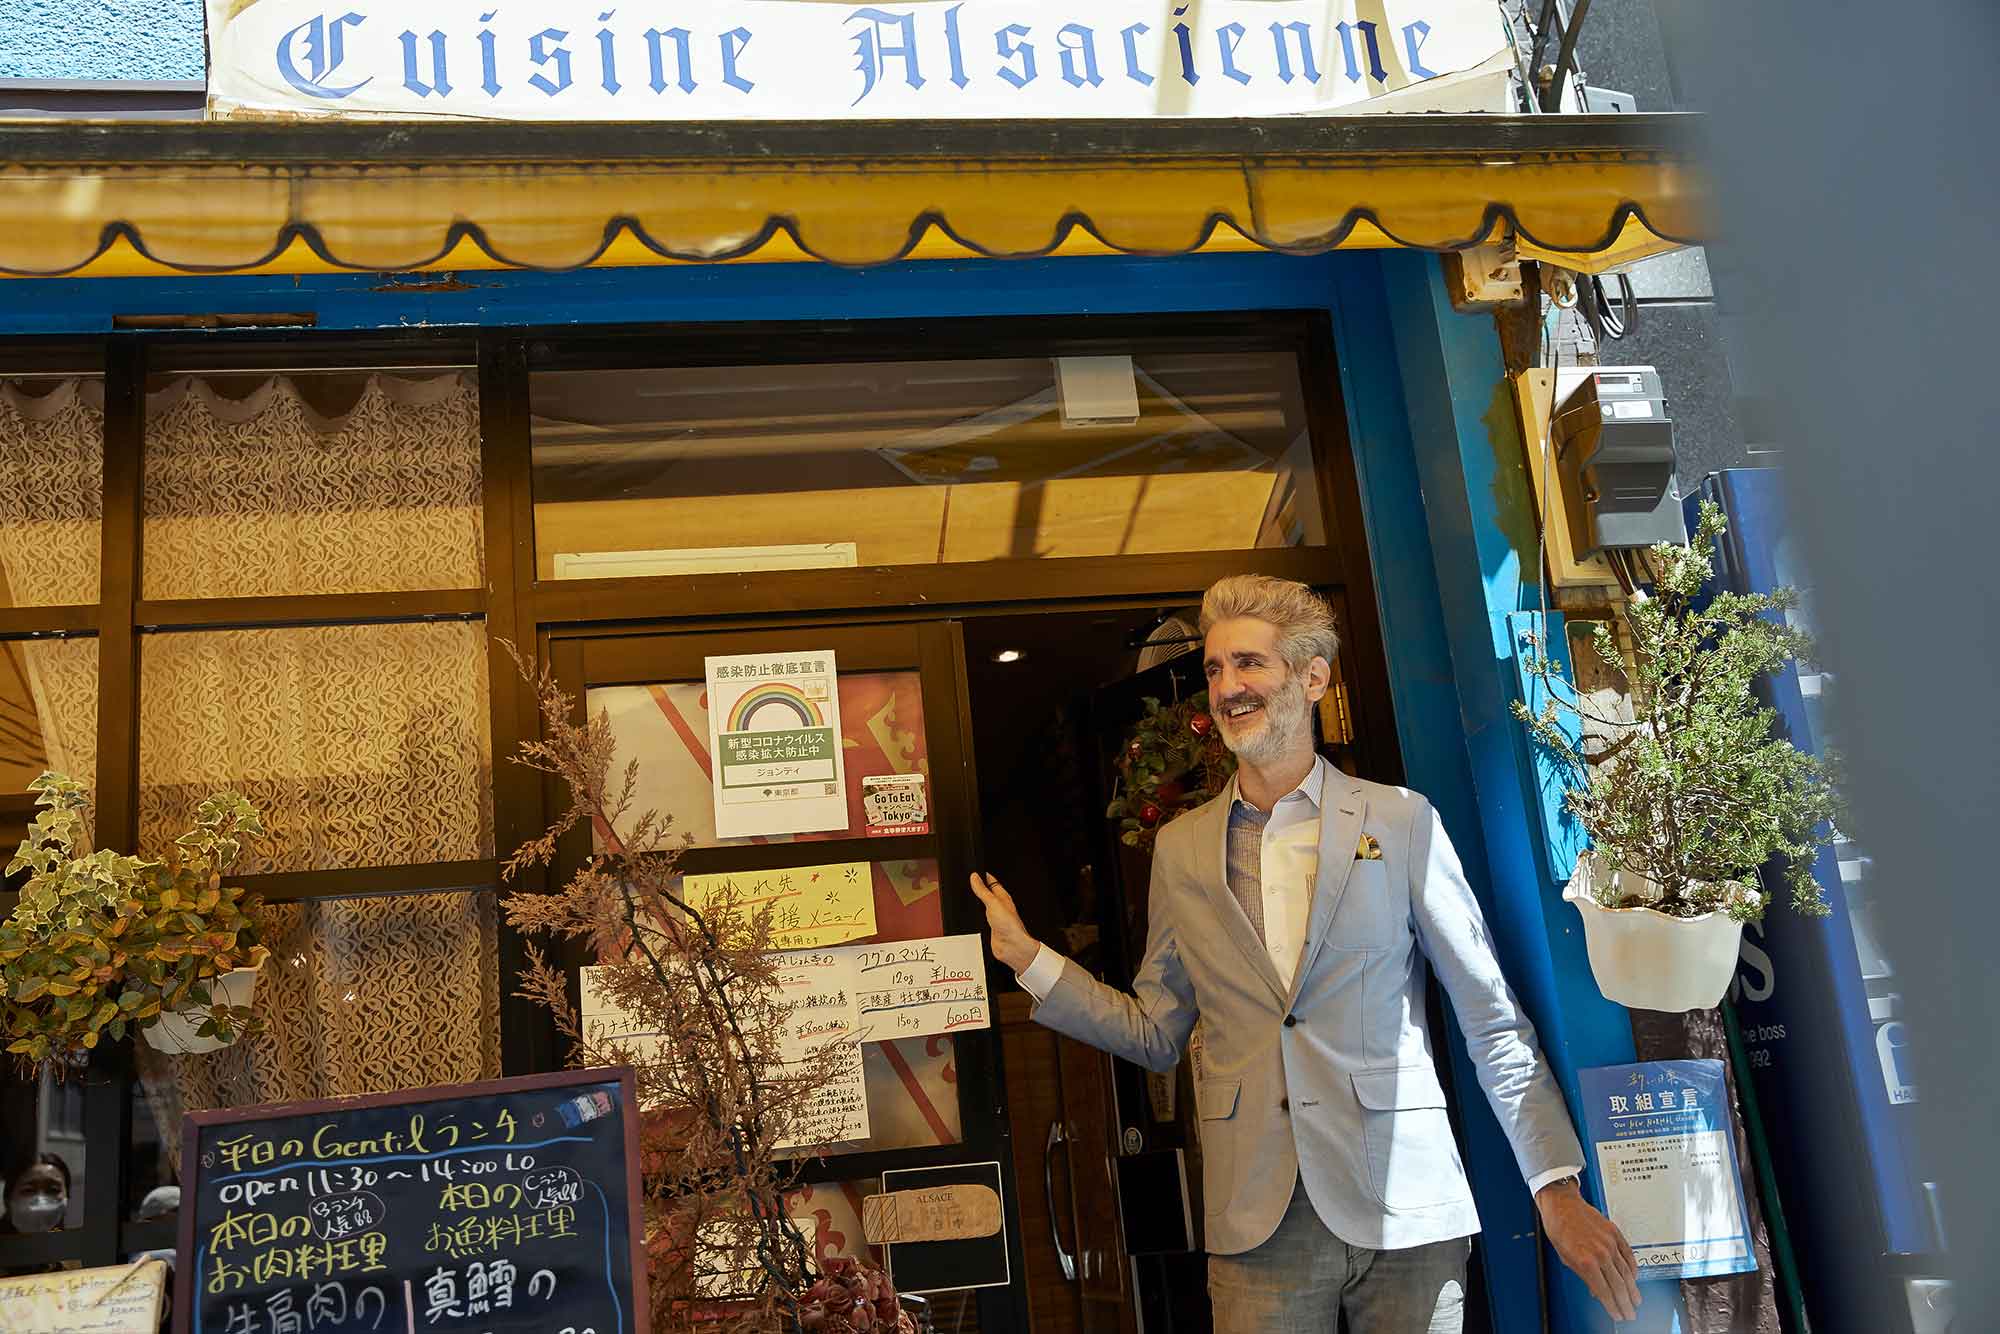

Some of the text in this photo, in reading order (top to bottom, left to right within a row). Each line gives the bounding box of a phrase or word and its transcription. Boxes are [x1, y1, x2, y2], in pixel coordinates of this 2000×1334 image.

[275, 2, 1440, 107] Cuisine Alsacienne
[716, 660, 826, 679] 感染防止徹底宣言
[727, 733, 825, 750] 新型コロナウイルス
[735, 745, 820, 761] 感染拡大防止中
[874, 792, 916, 803] Go To Eat
[883, 811, 910, 823] Tokyo
[1758, 1024, 1786, 1041] boss
[1608, 1087, 1700, 1114] 取組宣言
[219, 1176, 300, 1206] open
[307, 1166, 379, 1197] 11:30
[421, 1159, 498, 1183] 14:00
[505, 1152, 536, 1171] LO
[439, 1182, 523, 1212] 本日の
[208, 1209, 312, 1254] 本日の
[424, 1205, 579, 1259] お魚料理
[208, 1232, 388, 1294] お肉料理
[424, 1258, 557, 1324] 真鱈の
